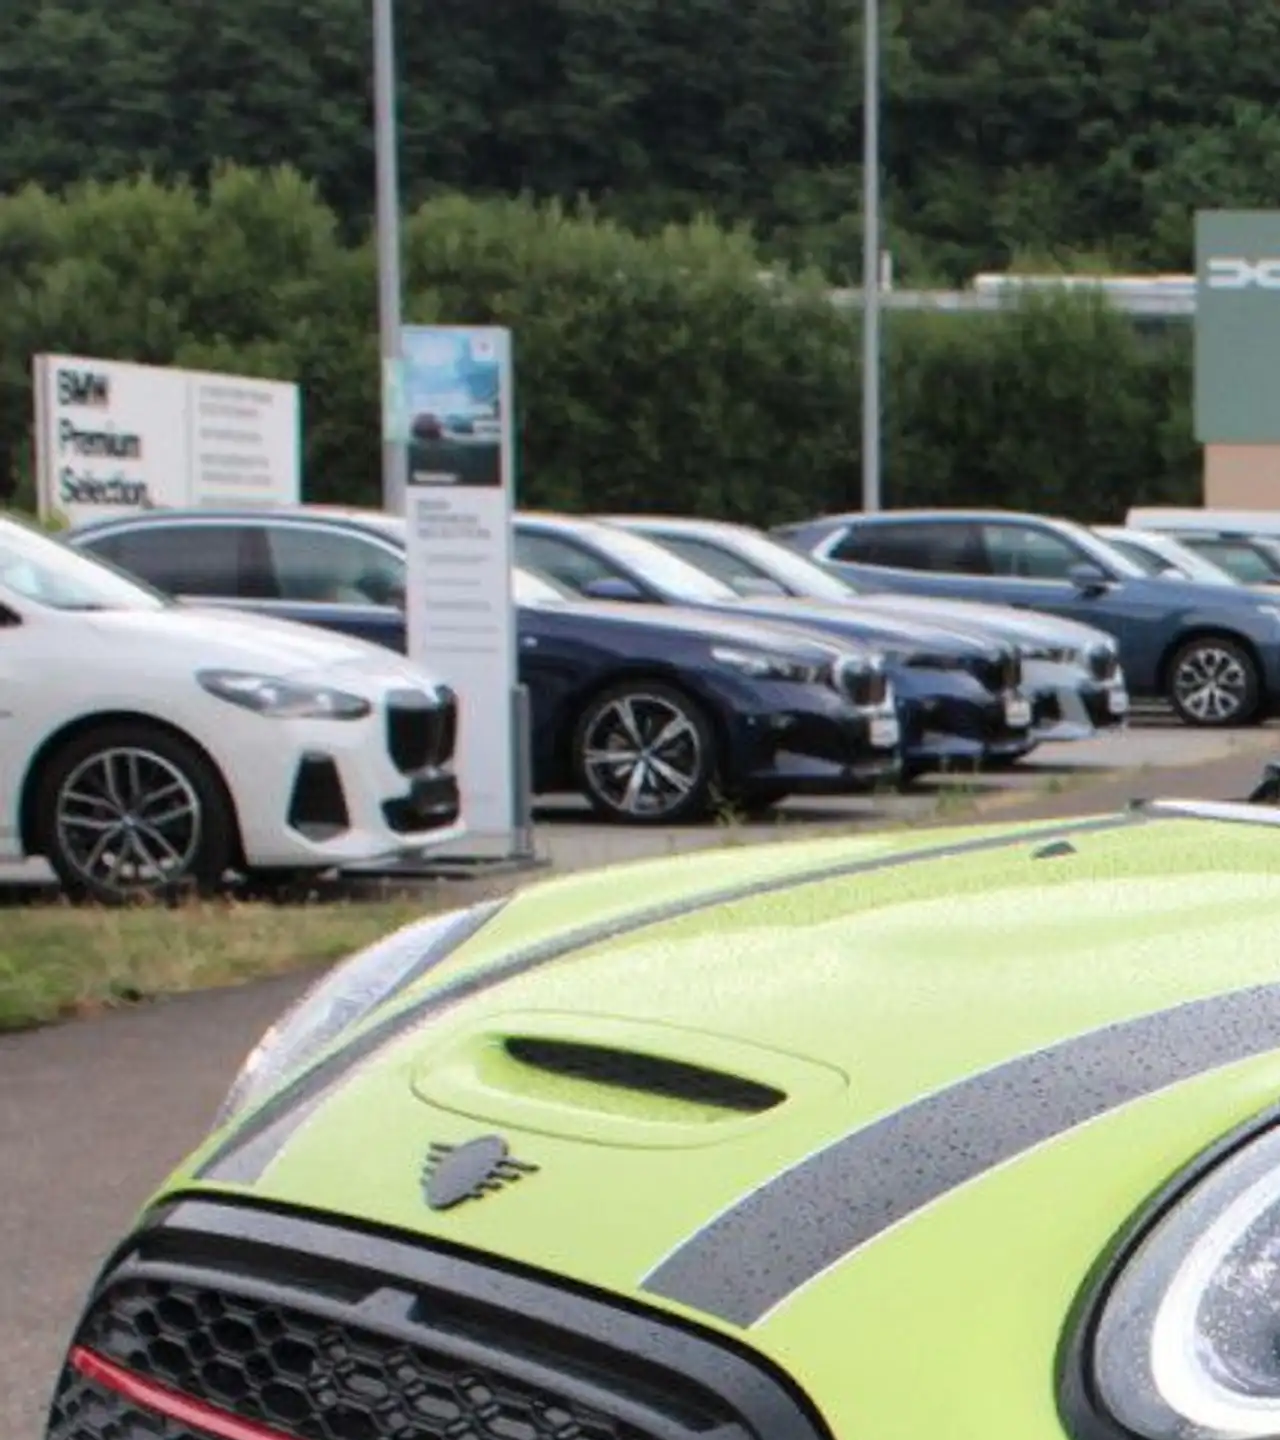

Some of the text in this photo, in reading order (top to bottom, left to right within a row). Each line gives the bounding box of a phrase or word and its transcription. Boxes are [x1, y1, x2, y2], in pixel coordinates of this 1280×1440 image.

[57, 369, 109, 410] BMW
[58, 416, 142, 459] Premium
[60, 466, 149, 506] Selection
